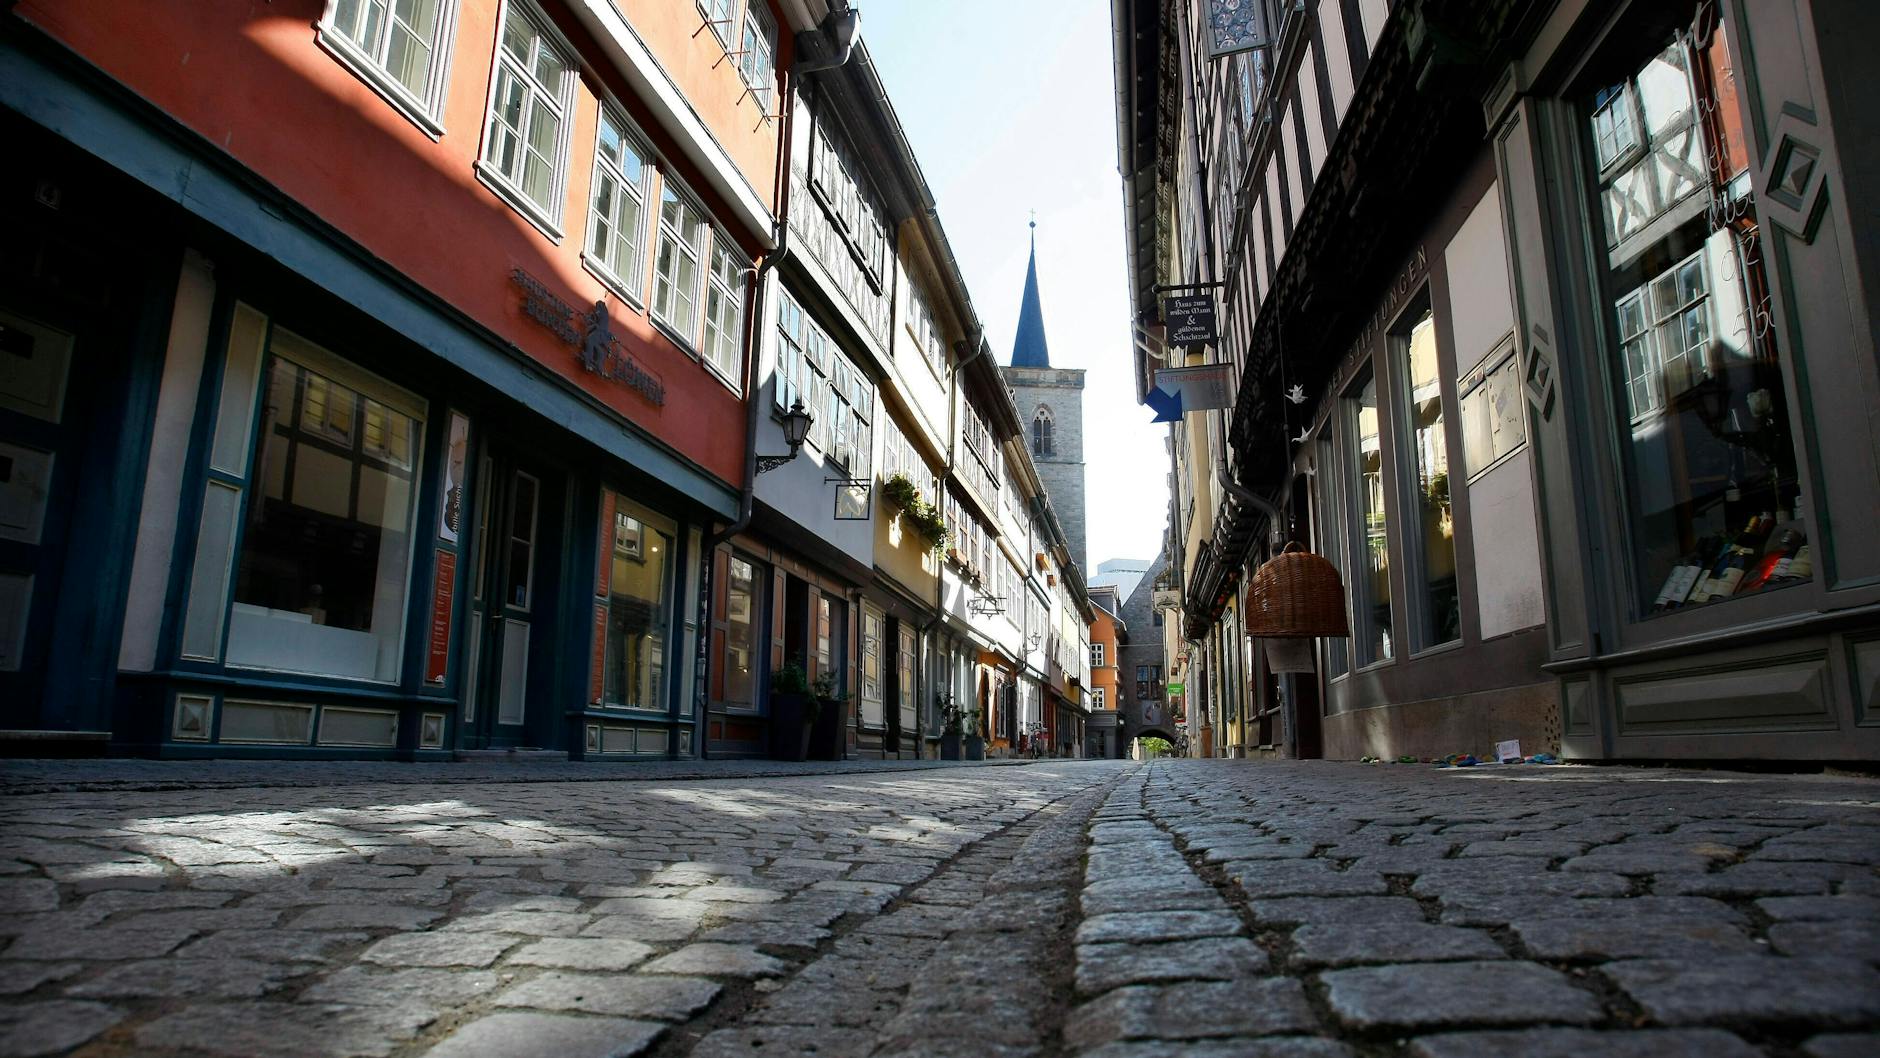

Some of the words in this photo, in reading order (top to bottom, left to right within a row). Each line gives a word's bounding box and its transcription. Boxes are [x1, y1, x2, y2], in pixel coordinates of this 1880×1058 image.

[1175, 300, 1192, 309] Haus
[1348, 244, 1428, 366] STIFTUNGEN
[1187, 314, 1196, 326] &
